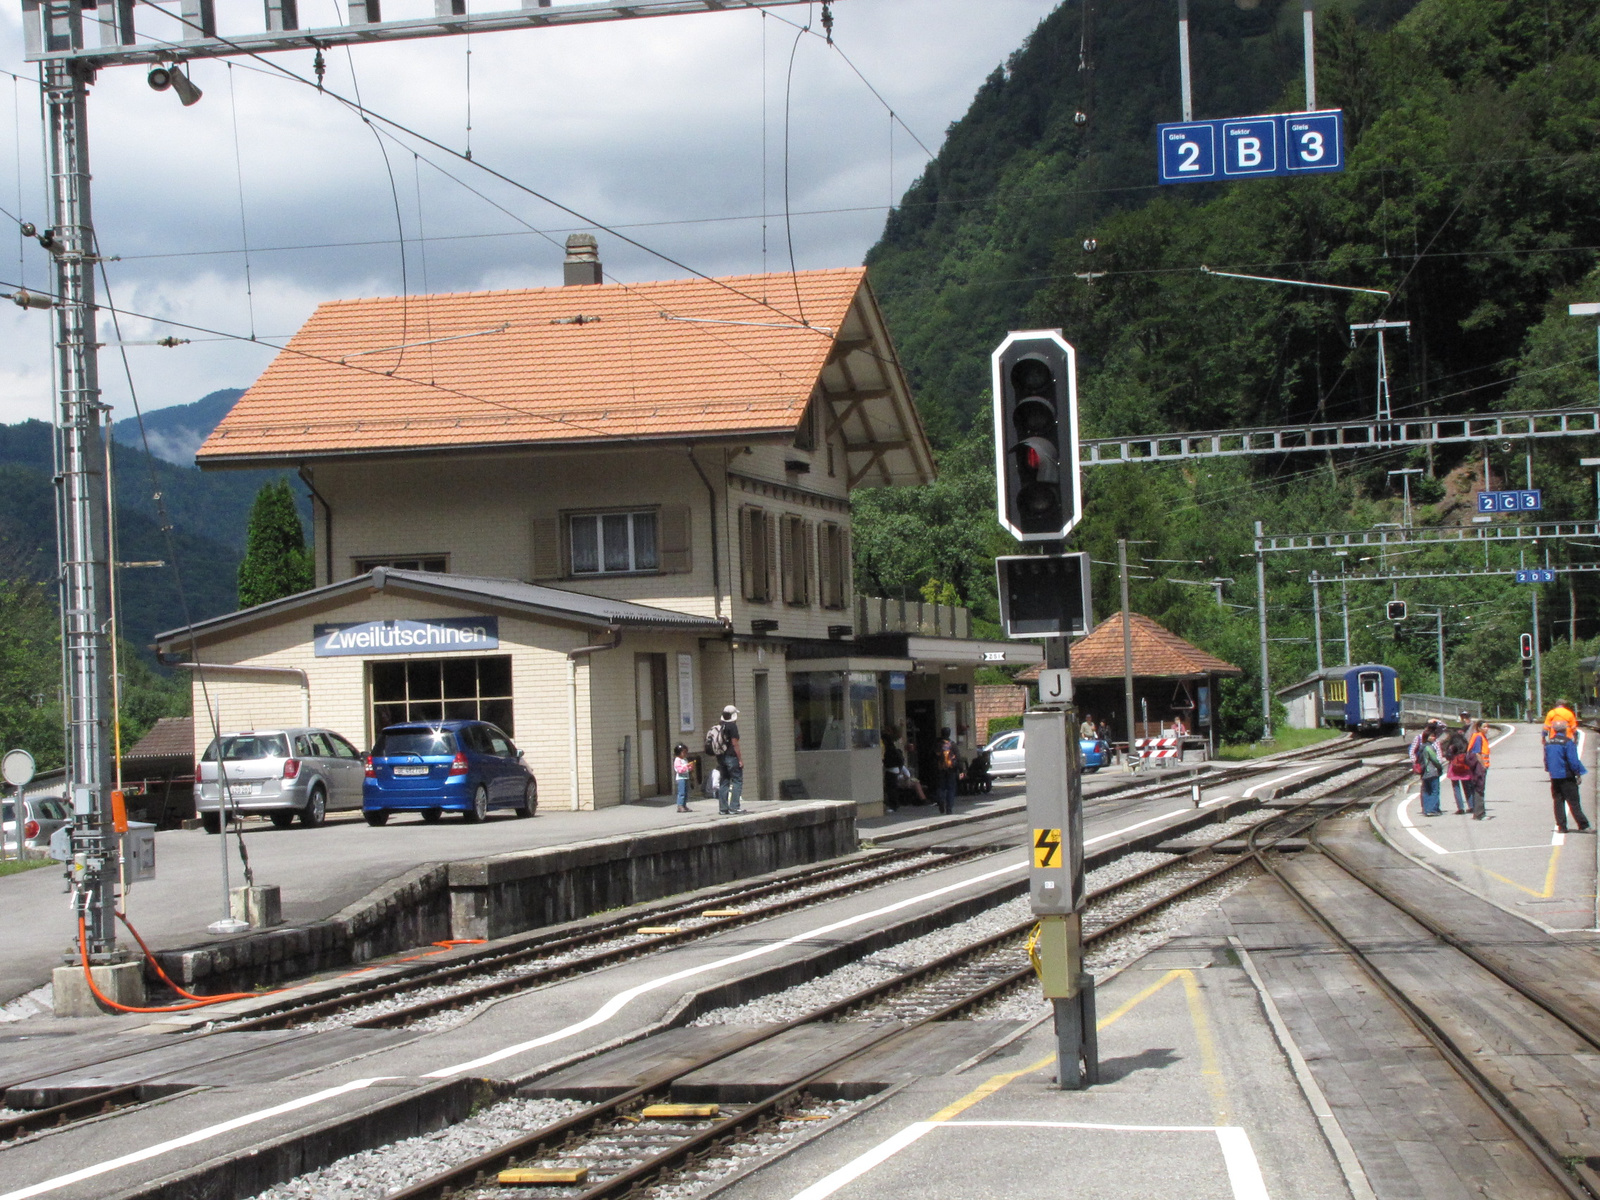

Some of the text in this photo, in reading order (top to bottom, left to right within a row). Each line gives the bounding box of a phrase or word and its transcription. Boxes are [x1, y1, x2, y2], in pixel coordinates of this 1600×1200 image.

[1168, 133, 1186, 141] Gleis
[1230, 128, 1250, 136] Sektor
[1178, 131, 1324, 172] 2 B 3
[1484, 496, 1535, 509] 2 C 3
[1545, 572, 1551, 580] 3
[324, 624, 488, 650] Zweilütschinen
[1049, 673, 1062, 697] J
